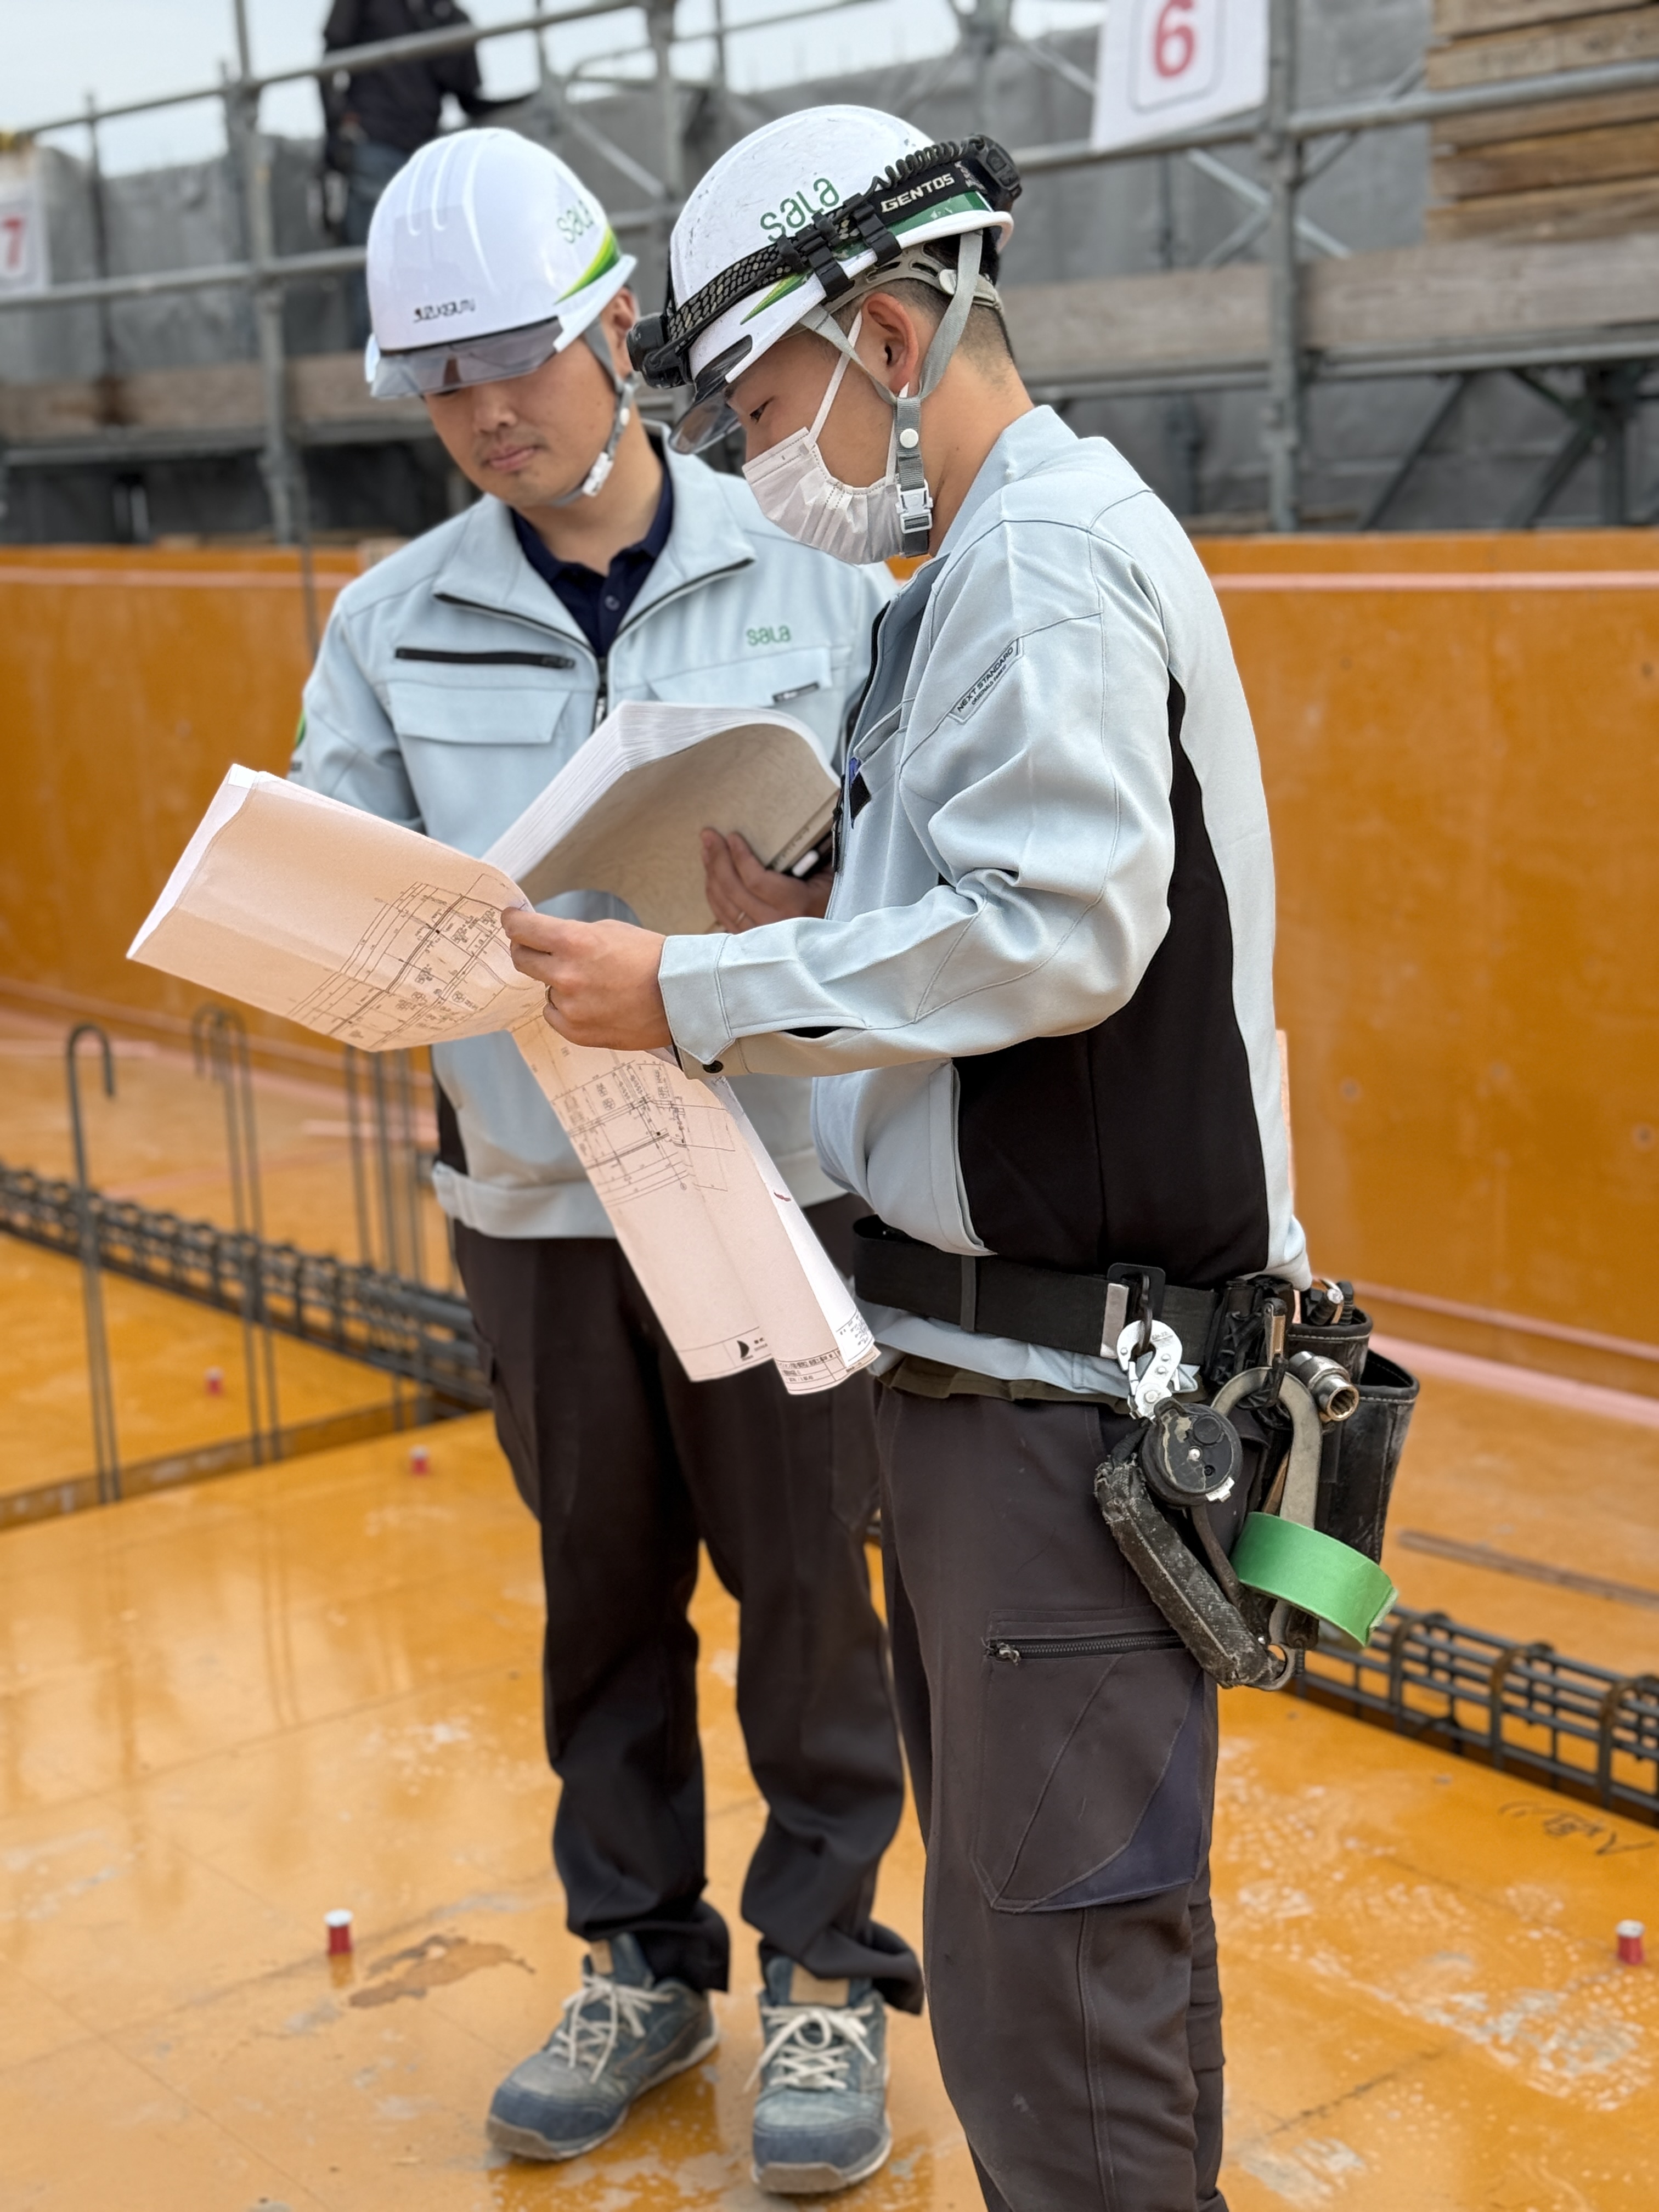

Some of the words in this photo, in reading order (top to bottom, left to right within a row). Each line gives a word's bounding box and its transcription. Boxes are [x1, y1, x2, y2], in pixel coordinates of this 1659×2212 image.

[1154, 0, 1195, 78] 6
[760, 178, 840, 242] sala
[881, 173, 955, 213] GENTOS
[0, 217, 26, 270] 7
[957, 687, 977, 712] NEXT
[977, 646, 1013, 690] STANDARD
